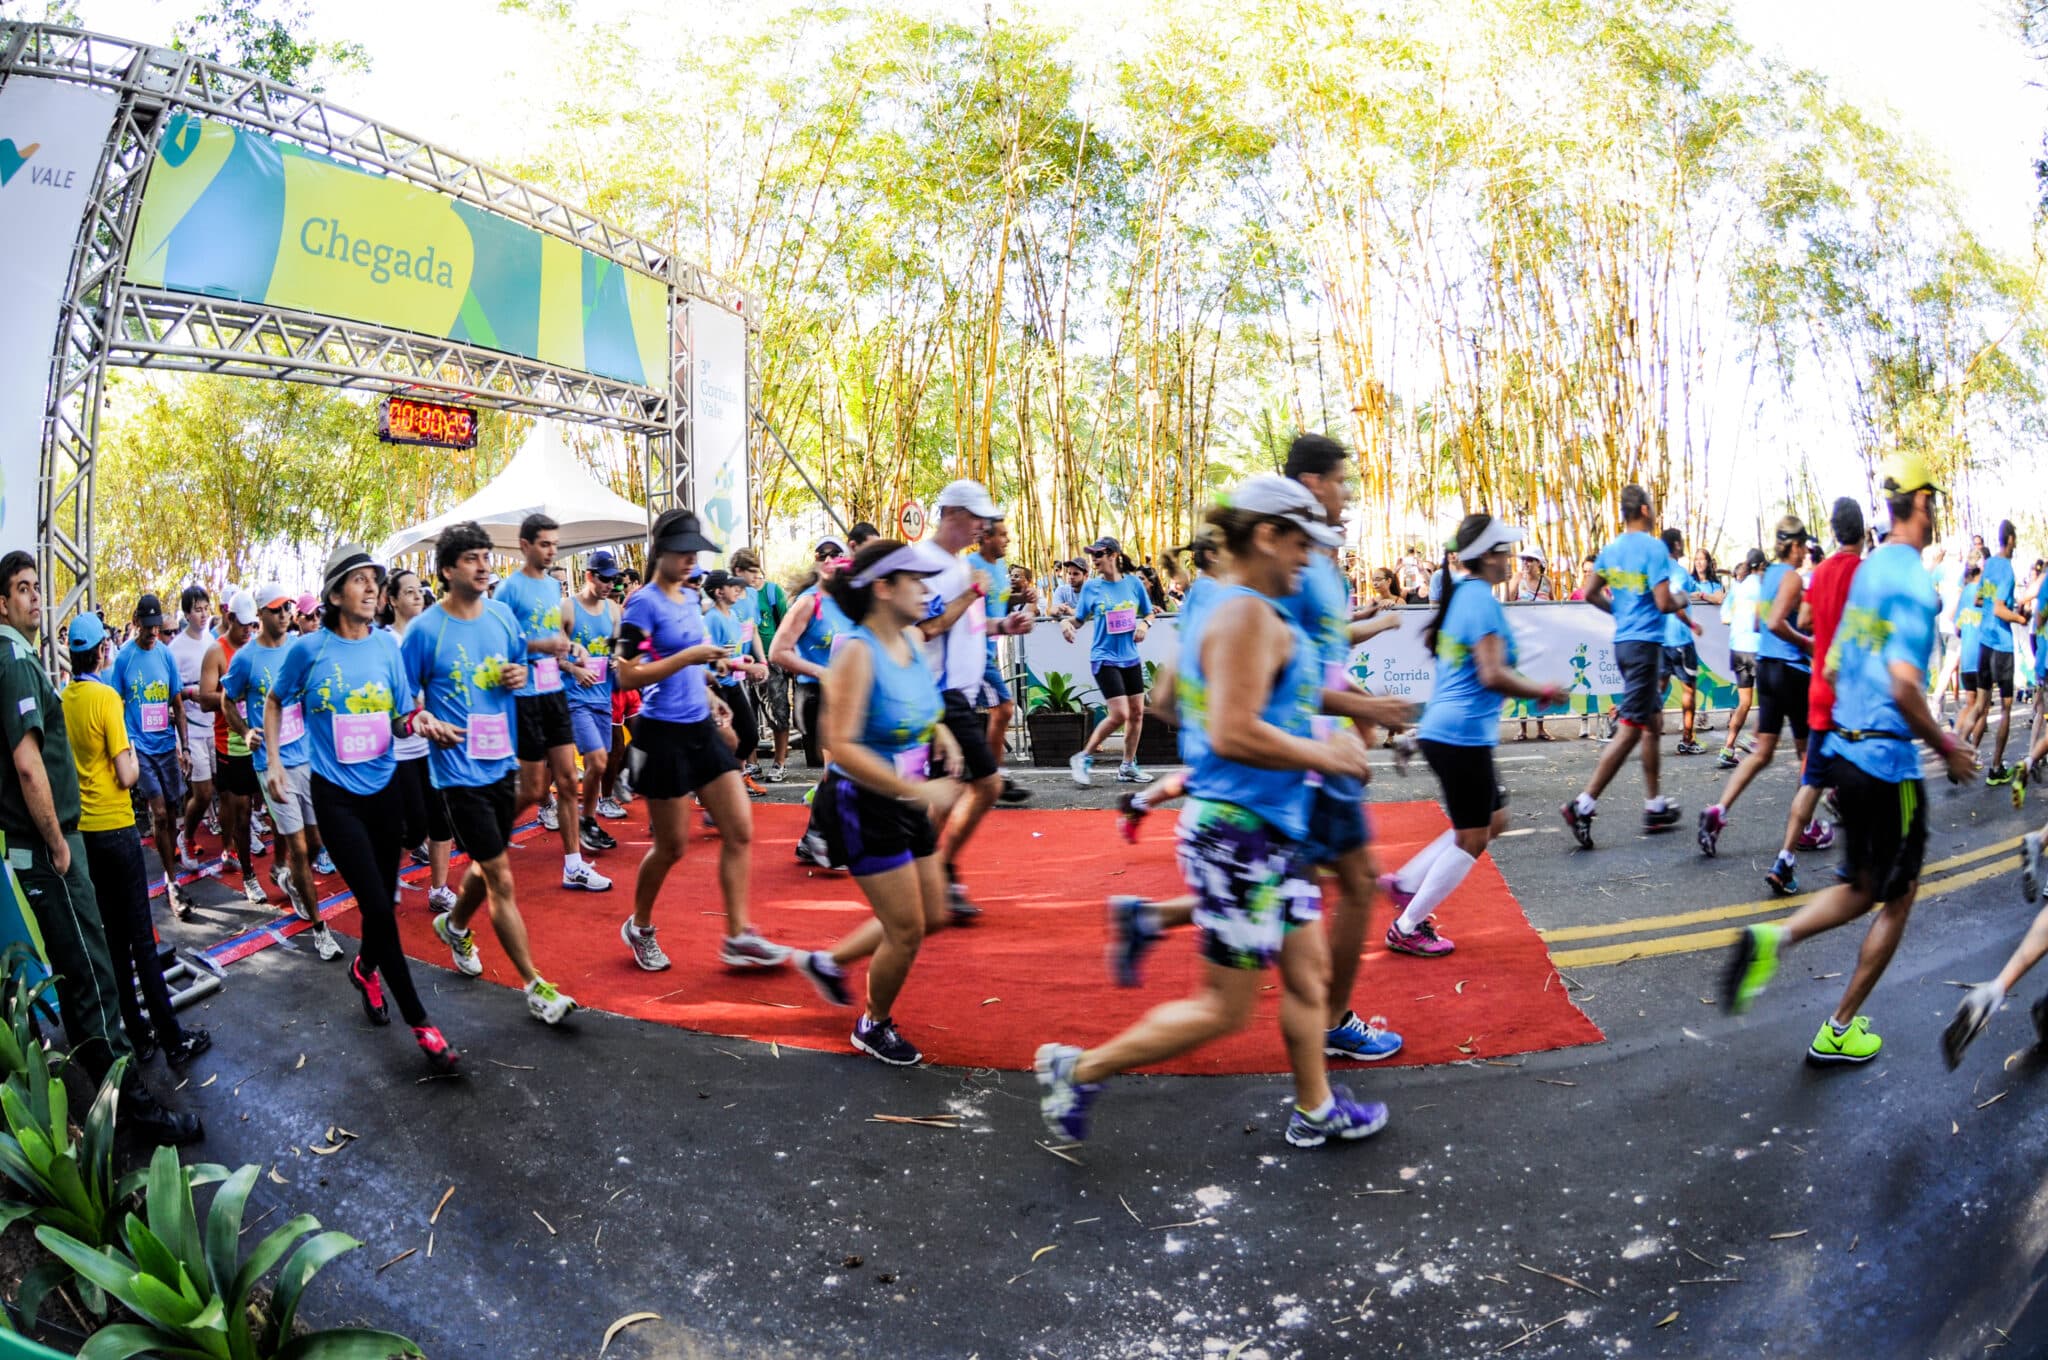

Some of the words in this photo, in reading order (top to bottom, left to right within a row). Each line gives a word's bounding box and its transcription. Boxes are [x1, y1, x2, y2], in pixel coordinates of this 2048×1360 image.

[32, 165, 76, 189] VALE
[299, 216, 453, 289] Chegada
[903, 511, 921, 527] 40
[1383, 669, 1430, 681] Corrida
[1599, 673, 1622, 684] Vale
[1384, 683, 1411, 695] Vale
[342, 733, 377, 753] 891
